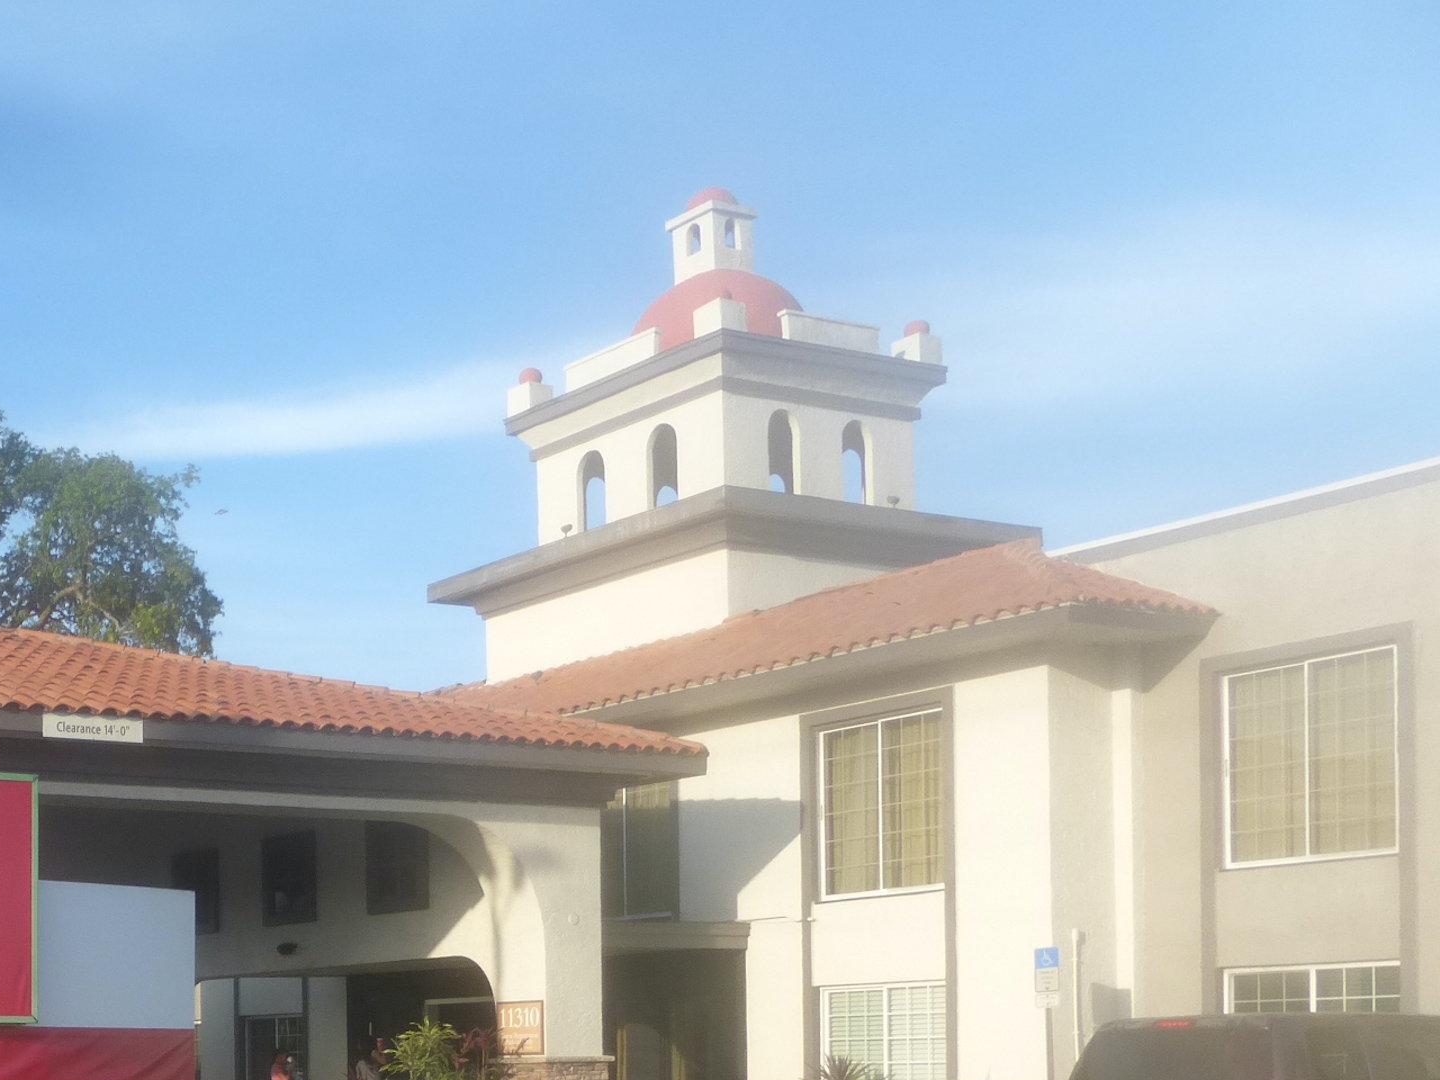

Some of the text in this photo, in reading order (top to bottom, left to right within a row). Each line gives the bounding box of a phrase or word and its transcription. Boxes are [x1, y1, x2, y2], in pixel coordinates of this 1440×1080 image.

[56, 720, 131, 737] Clearance 14'-0"
[500, 1006, 540, 1029] 11310
